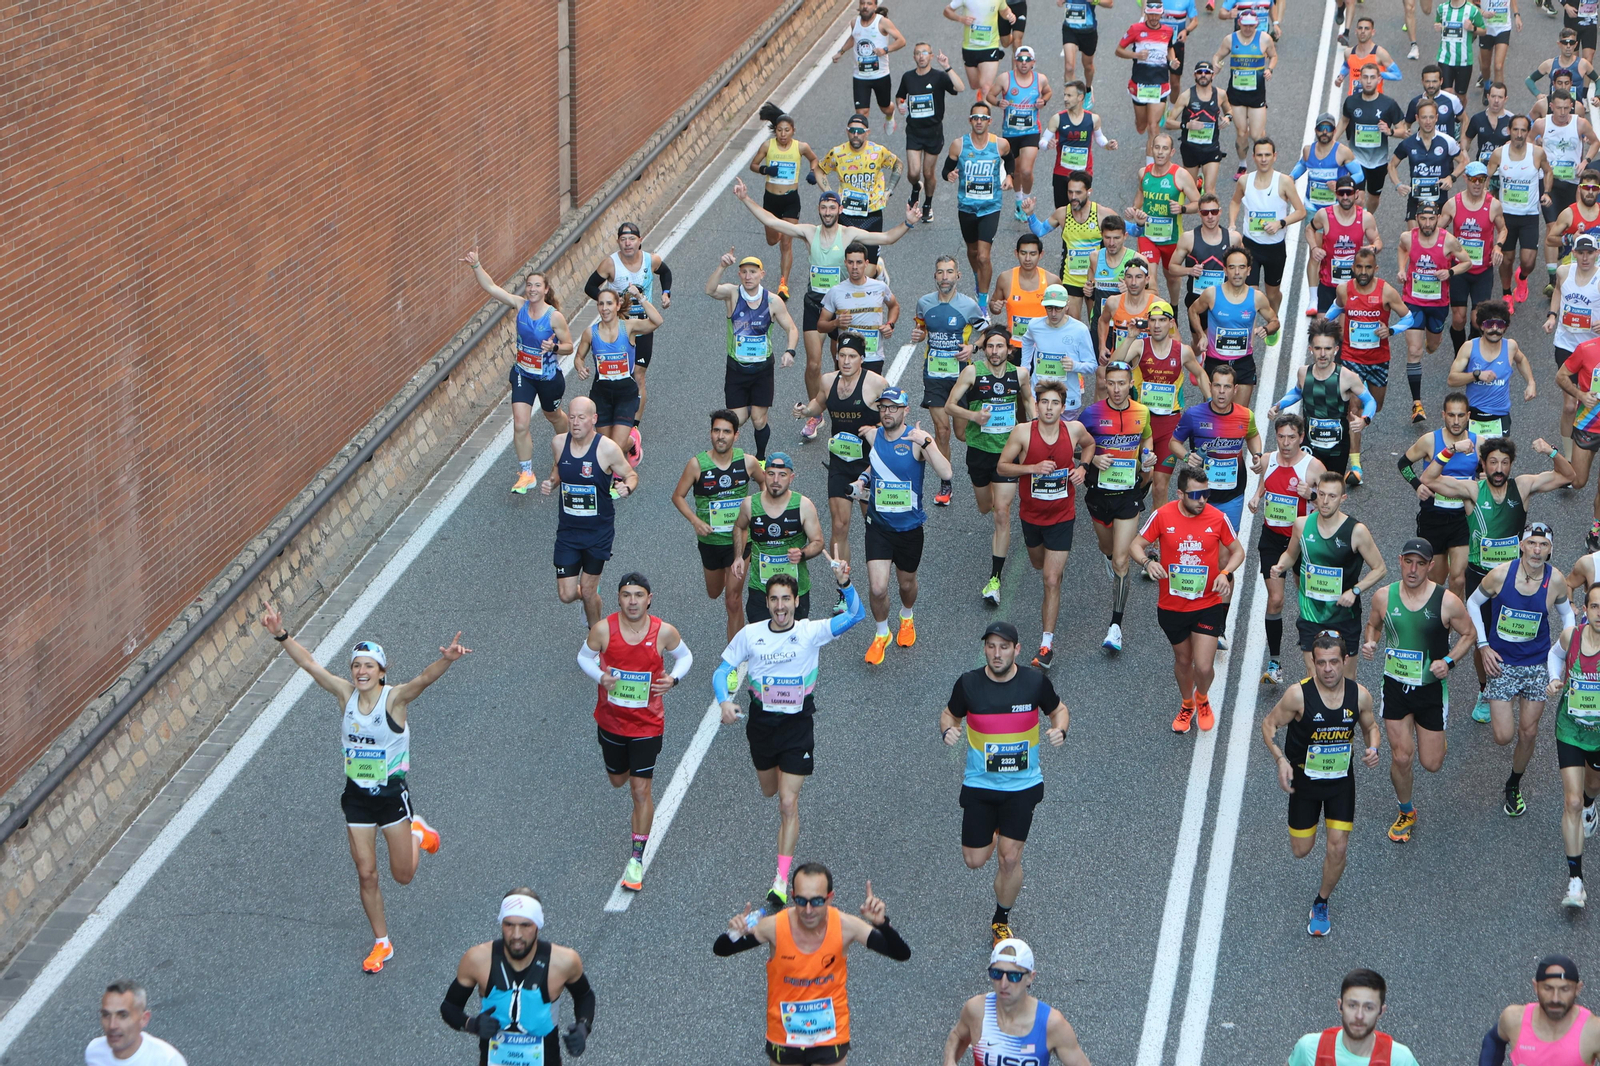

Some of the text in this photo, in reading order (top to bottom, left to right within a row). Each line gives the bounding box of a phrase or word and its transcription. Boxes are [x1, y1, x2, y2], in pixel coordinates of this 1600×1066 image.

[1564, 291, 1591, 305] PHOENIX
[1347, 309, 1380, 317] MOROCCO
[524, 347, 540, 355] ZURICH
[840, 434, 859, 442] ZURICH
[723, 500, 743, 508] ZURICH
[1273, 496, 1293, 504] ZURICH
[1316, 568, 1338, 576] ZURICH
[1514, 612, 1536, 620] ZURICH
[1395, 651, 1418, 659] ZURICH
[622, 673, 646, 681] ZURICH
[348, 734, 377, 746] SYB
[1001, 744, 1025, 753] ZURICH
[358, 750, 382, 759] ZURICH
[507, 1035, 537, 1044] ZURICH
